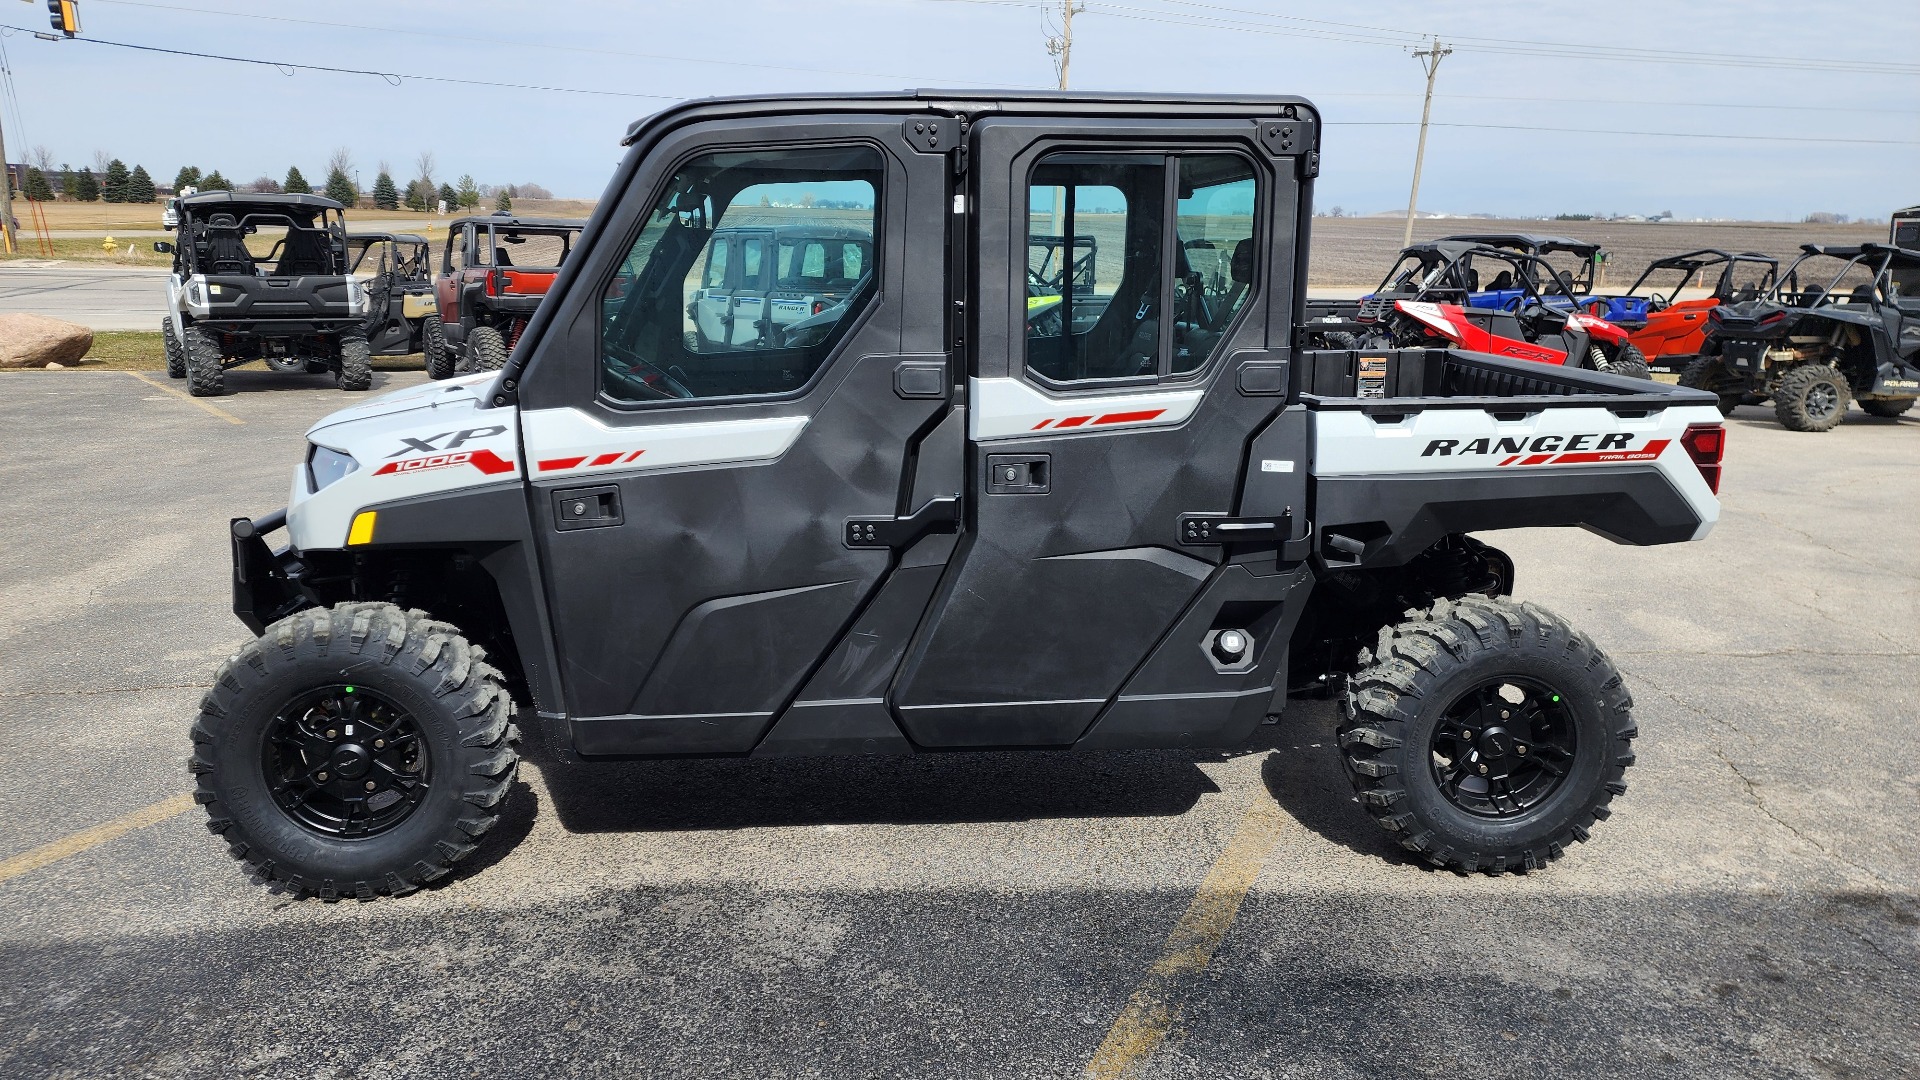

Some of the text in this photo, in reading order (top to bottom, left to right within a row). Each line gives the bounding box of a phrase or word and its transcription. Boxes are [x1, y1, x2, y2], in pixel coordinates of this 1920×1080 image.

[1883, 380, 1919, 388] POLARIS
[382, 425, 508, 459] XP
[1420, 432, 1636, 457] RANGER
[395, 452, 473, 472] 1000
